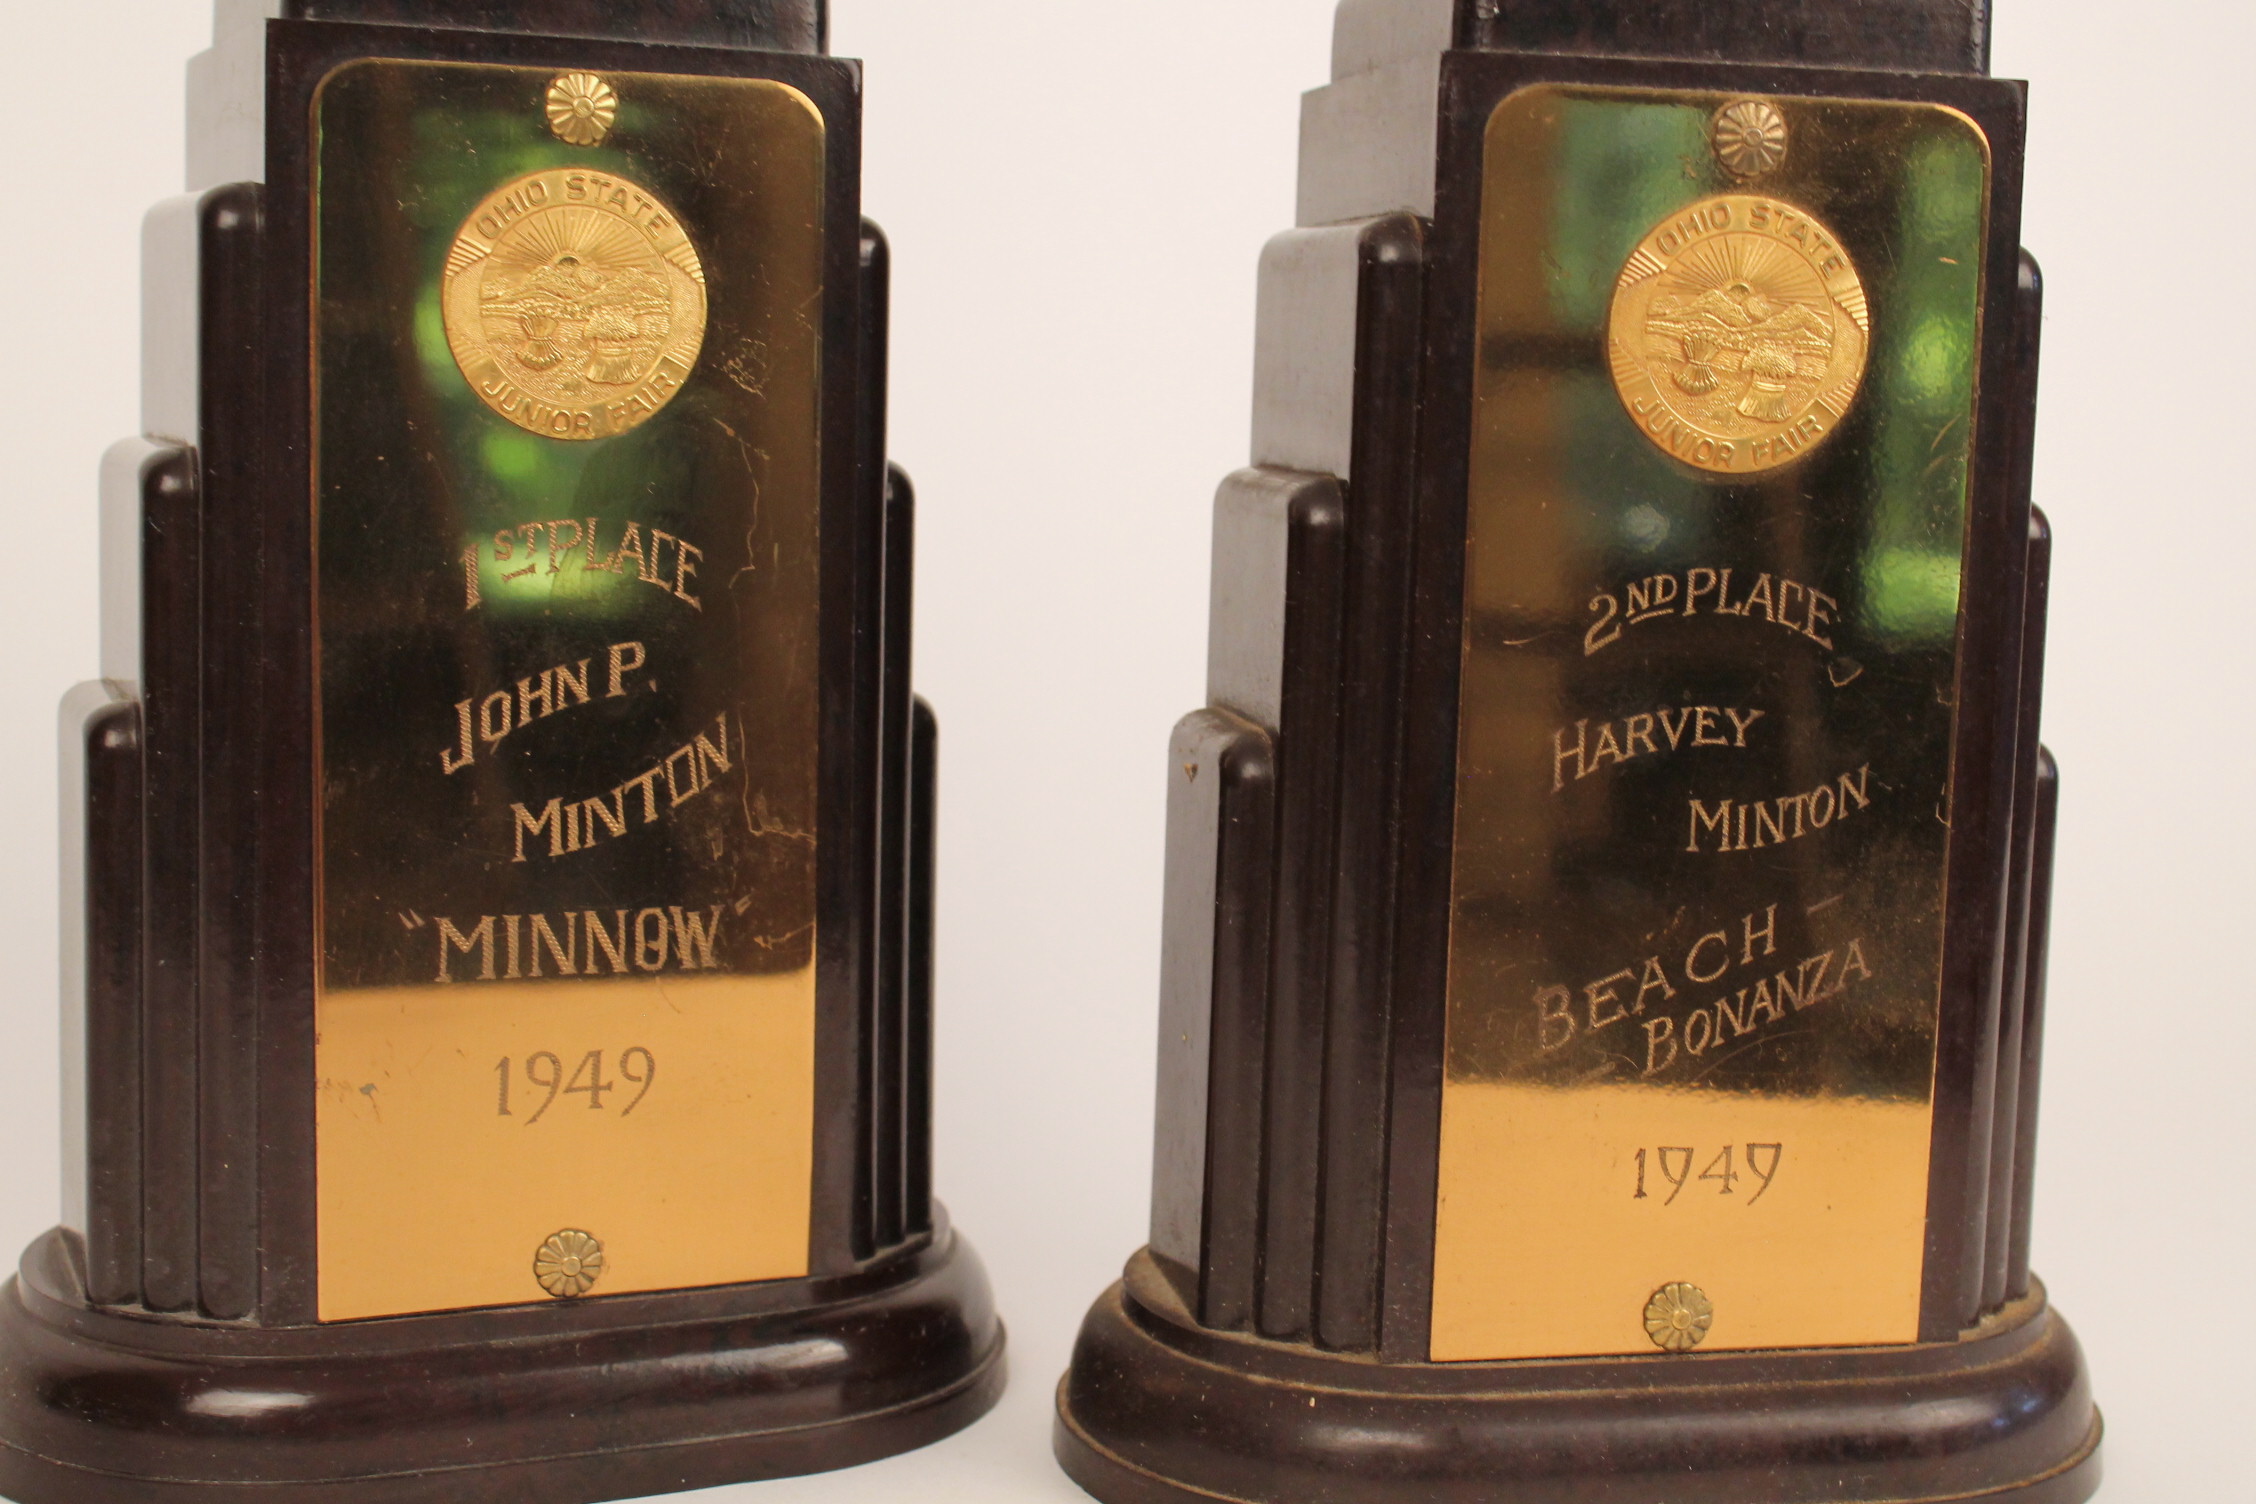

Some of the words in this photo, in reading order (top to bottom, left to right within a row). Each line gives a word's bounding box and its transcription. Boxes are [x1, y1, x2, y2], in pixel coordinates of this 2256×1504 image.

[477, 180, 548, 239] OHIO
[566, 175, 670, 239] STATE
[1657, 203, 1732, 256] OHIO
[1749, 203, 1845, 280] STATE
[481, 380, 594, 436] JUNIOR
[607, 371, 676, 428] FAIR
[1634, 397, 1735, 467] JUNIOR
[1752, 414, 1824, 464] FAIR
[439, 657, 591, 775] JOHN
[1551, 705, 1765, 793] HARVEY
[510, 711, 733, 862] MINTON
[1685, 763, 1871, 852] MINTON
[1534, 903, 1778, 1052] BEACH
[1641, 937, 1872, 1079] BONANZA
[494, 1045, 656, 1126] 1949
[1633, 1142, 1782, 1206] 1949
